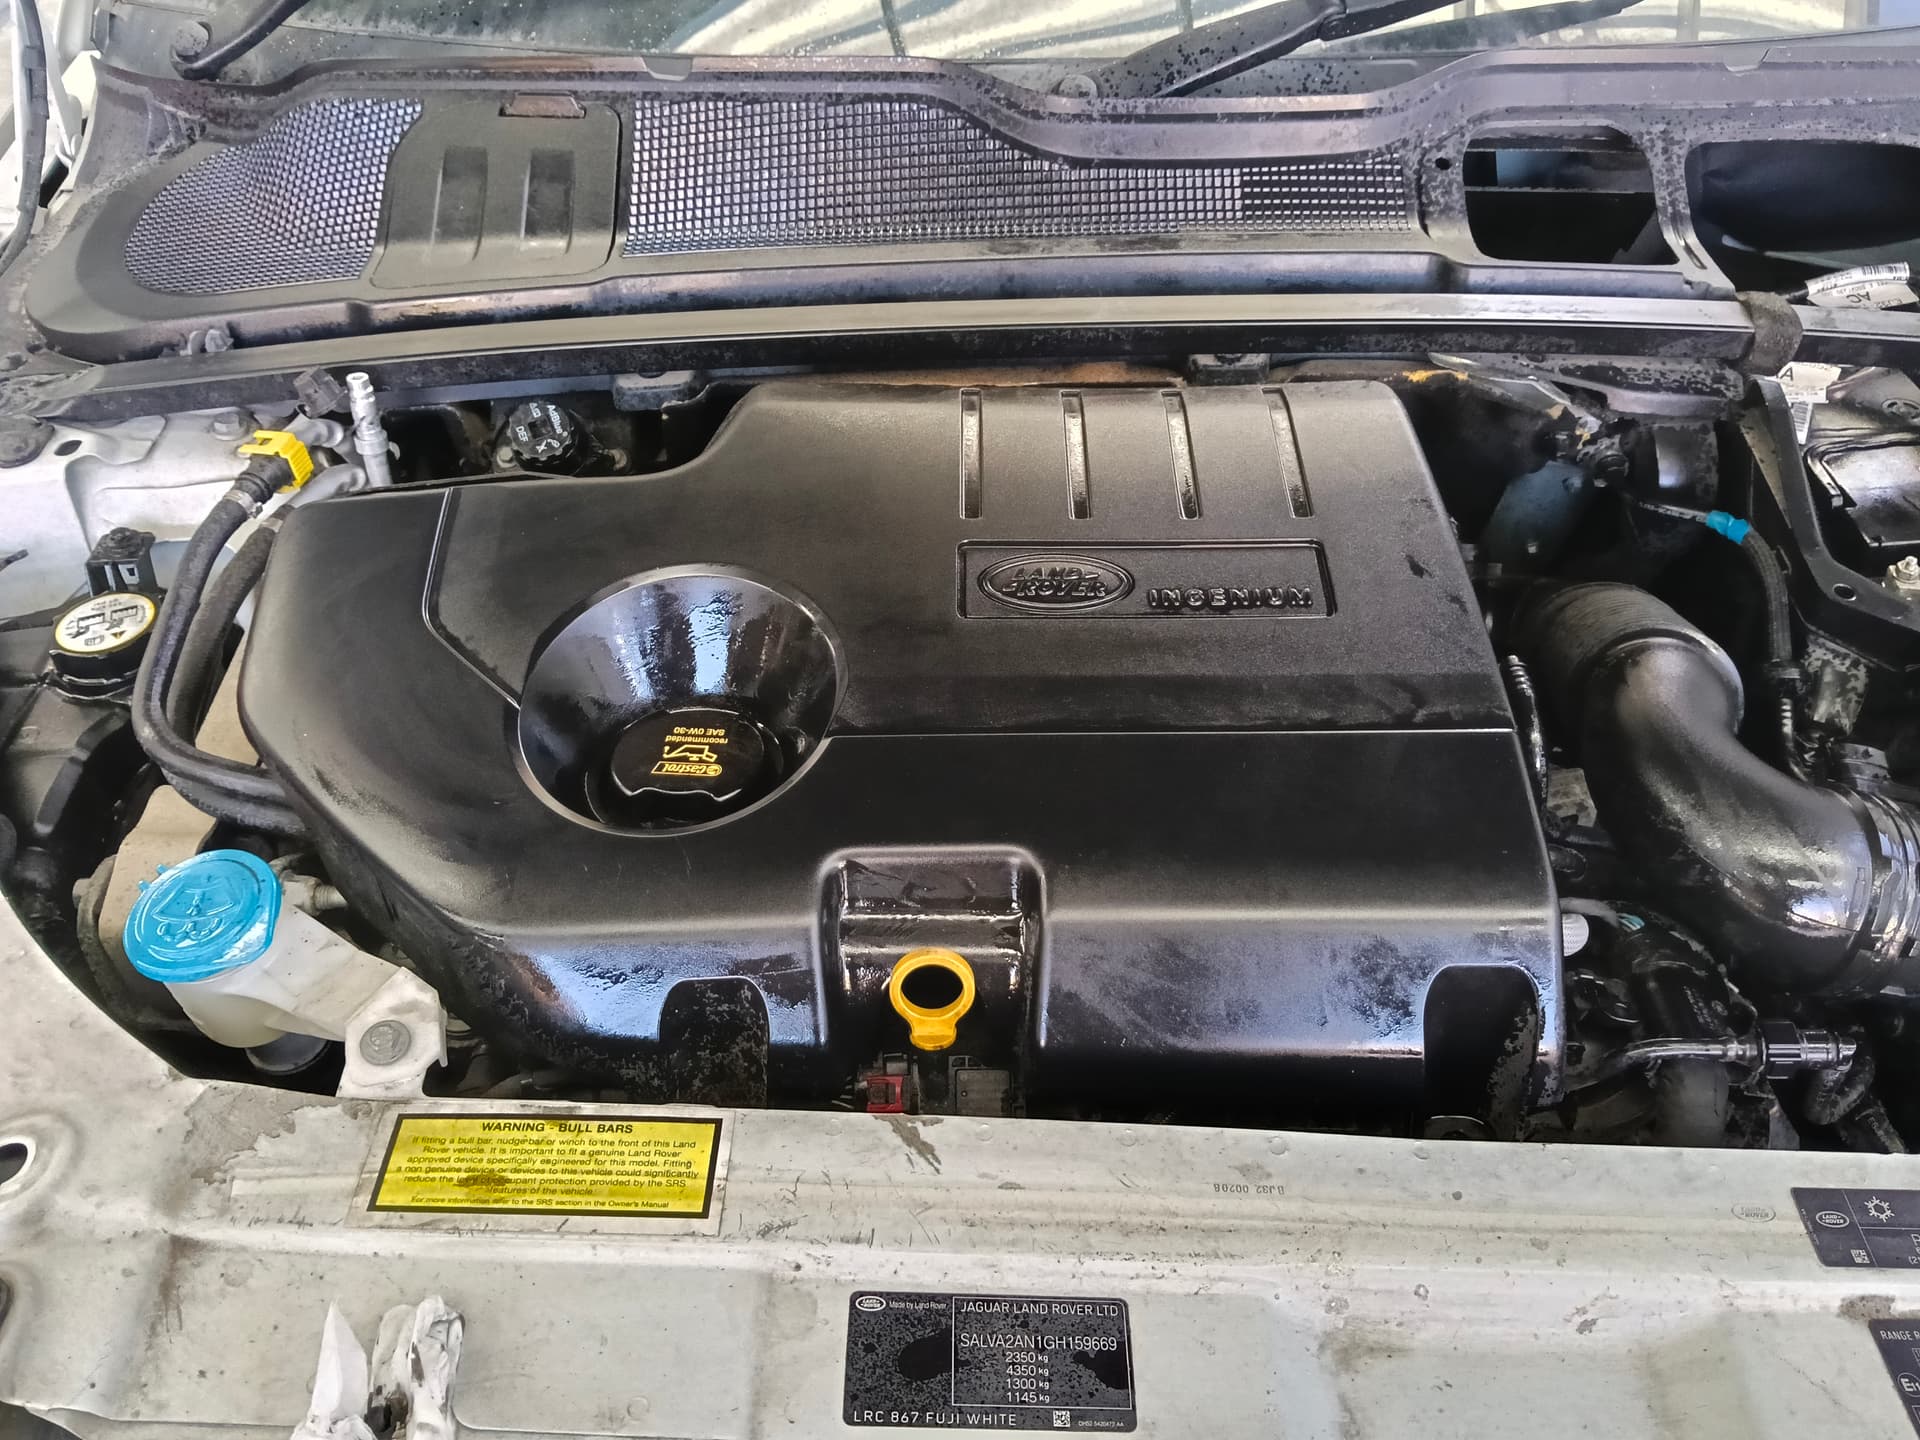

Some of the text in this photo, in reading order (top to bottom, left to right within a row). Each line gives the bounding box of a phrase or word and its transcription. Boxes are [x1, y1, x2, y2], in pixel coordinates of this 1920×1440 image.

[547, 405, 562, 434] AdBlue
[516, 426, 528, 442] DEF
[1149, 587, 1314, 608] INGENIUM
[673, 727, 725, 736] SAE 0W-30
[665, 735, 728, 745] recommended
[662, 763, 706, 775] Castrol
[482, 1122, 545, 1132] WARNING
[559, 1123, 592, 1133] BULL
[597, 1124, 633, 1134] BARS
[412, 1136, 419, 1144] If
[421, 1136, 446, 1145] fitting
[458, 1136, 475, 1145] bull
[497, 1138, 526, 1146] nudge
[600, 1139, 615, 1147] the
[654, 1140, 670, 1148] this
[673, 1140, 696, 1149] Land
[423, 1145, 450, 1153] Rover
[509, 1147, 554, 1156] important
[588, 1149, 625, 1157] genuine
[653, 1150, 682, 1158] Rover
[407, 1156, 451, 1164] approved
[486, 1157, 537, 1166] specifically
[663, 1160, 692, 1169] Fitting
[425, 1166, 462, 1174] genuine
[464, 1166, 495, 1174] device
[580, 1168, 613, 1176] vehicle
[644, 1170, 699, 1179] significantly
[540, 1178, 587, 1186] protection
[590, 1179, 631, 1187] provided
[633, 1180, 645, 1188] by
[665, 1180, 687, 1188] SRS
[543, 1187, 558, 1195] the
[536, 1198, 553, 1206] SRS
[608, 1200, 639, 1208] Owner's
[889, 1301, 947, 1310] Made by Land Rover
[960, 1301, 1119, 1317] JAGUAR LAND ROVER LTD
[960, 1333, 1118, 1351] SALVA2AN1GH159669
[1880, 1330, 1913, 1341] RANGE
[1005, 1351, 1049, 1364] 2350 kg
[1006, 1364, 1049, 1377] 4350 kg
[1006, 1377, 1050, 1390] 1300 kg
[1006, 1391, 1050, 1404] 1145 kg
[853, 1410, 1017, 1426] LRC 867 FUJI WHITE
